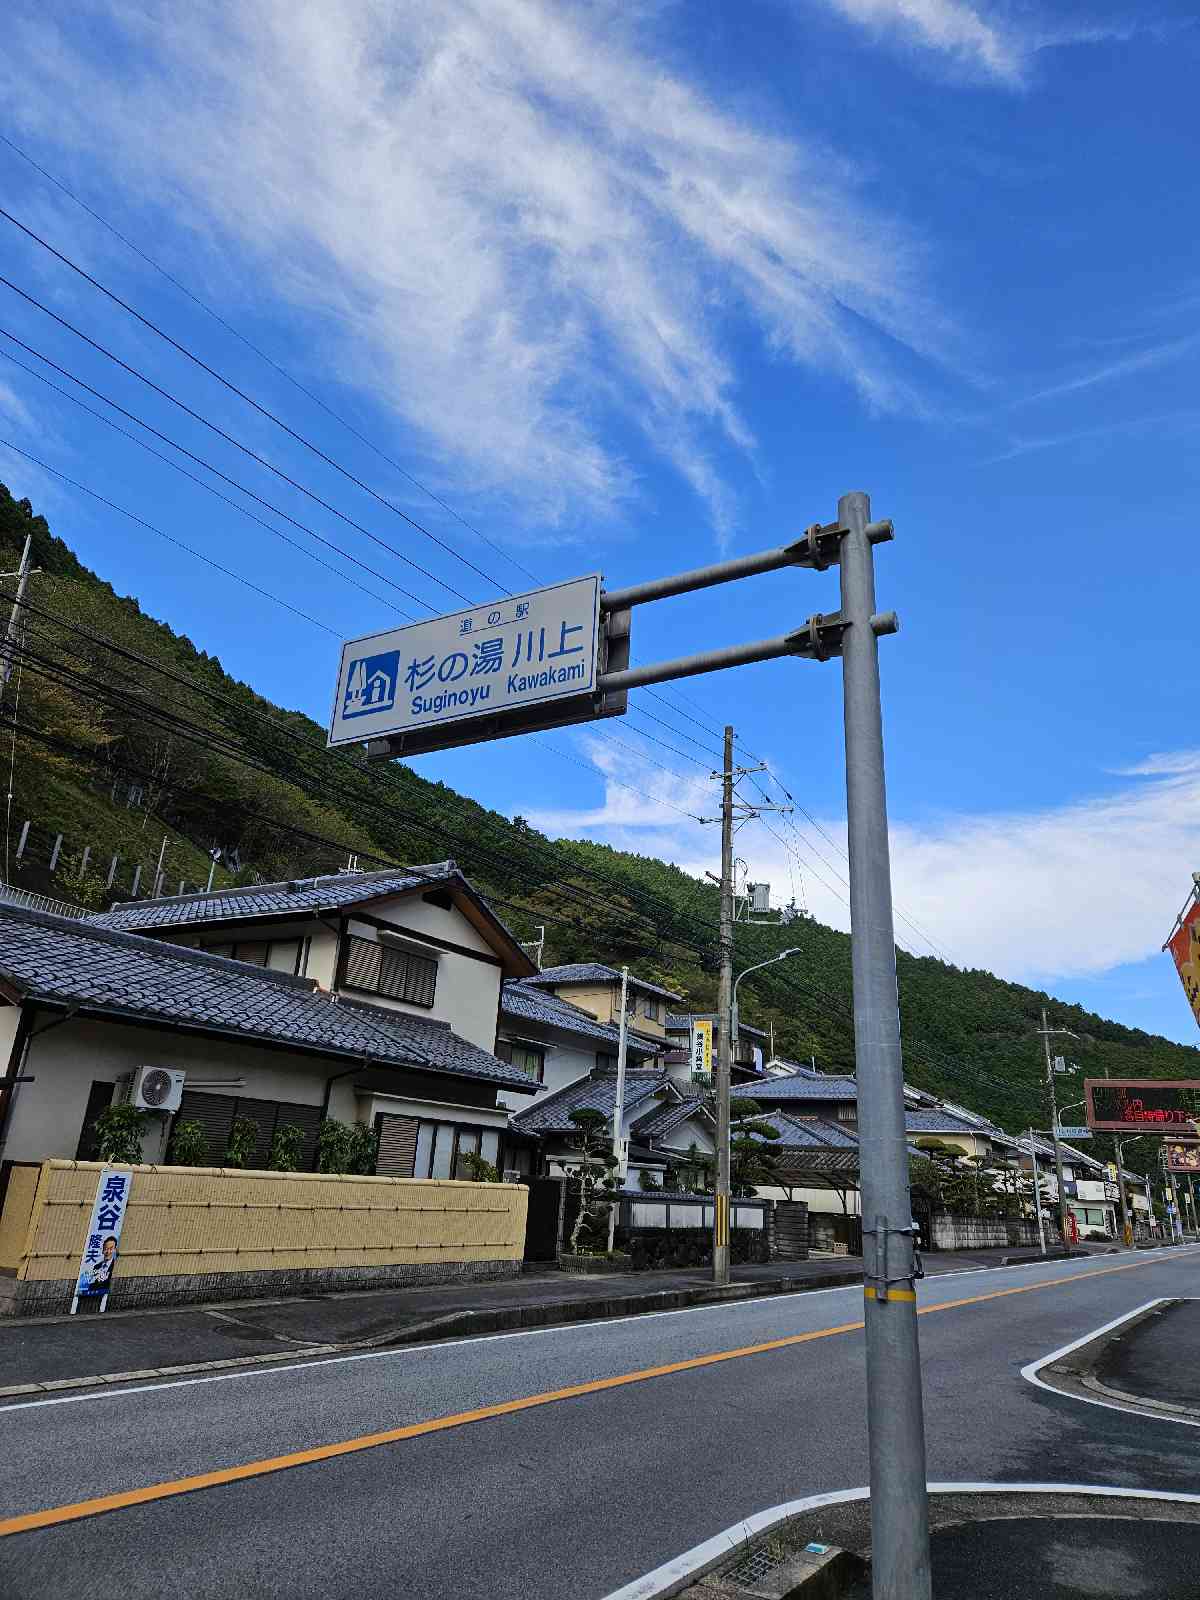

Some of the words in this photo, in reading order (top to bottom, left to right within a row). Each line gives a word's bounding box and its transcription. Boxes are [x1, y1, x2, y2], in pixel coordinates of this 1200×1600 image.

[460, 602, 530, 632] 道の駅
[411, 683, 490, 714] Suginoyu
[508, 660, 585, 693] Kawakami
